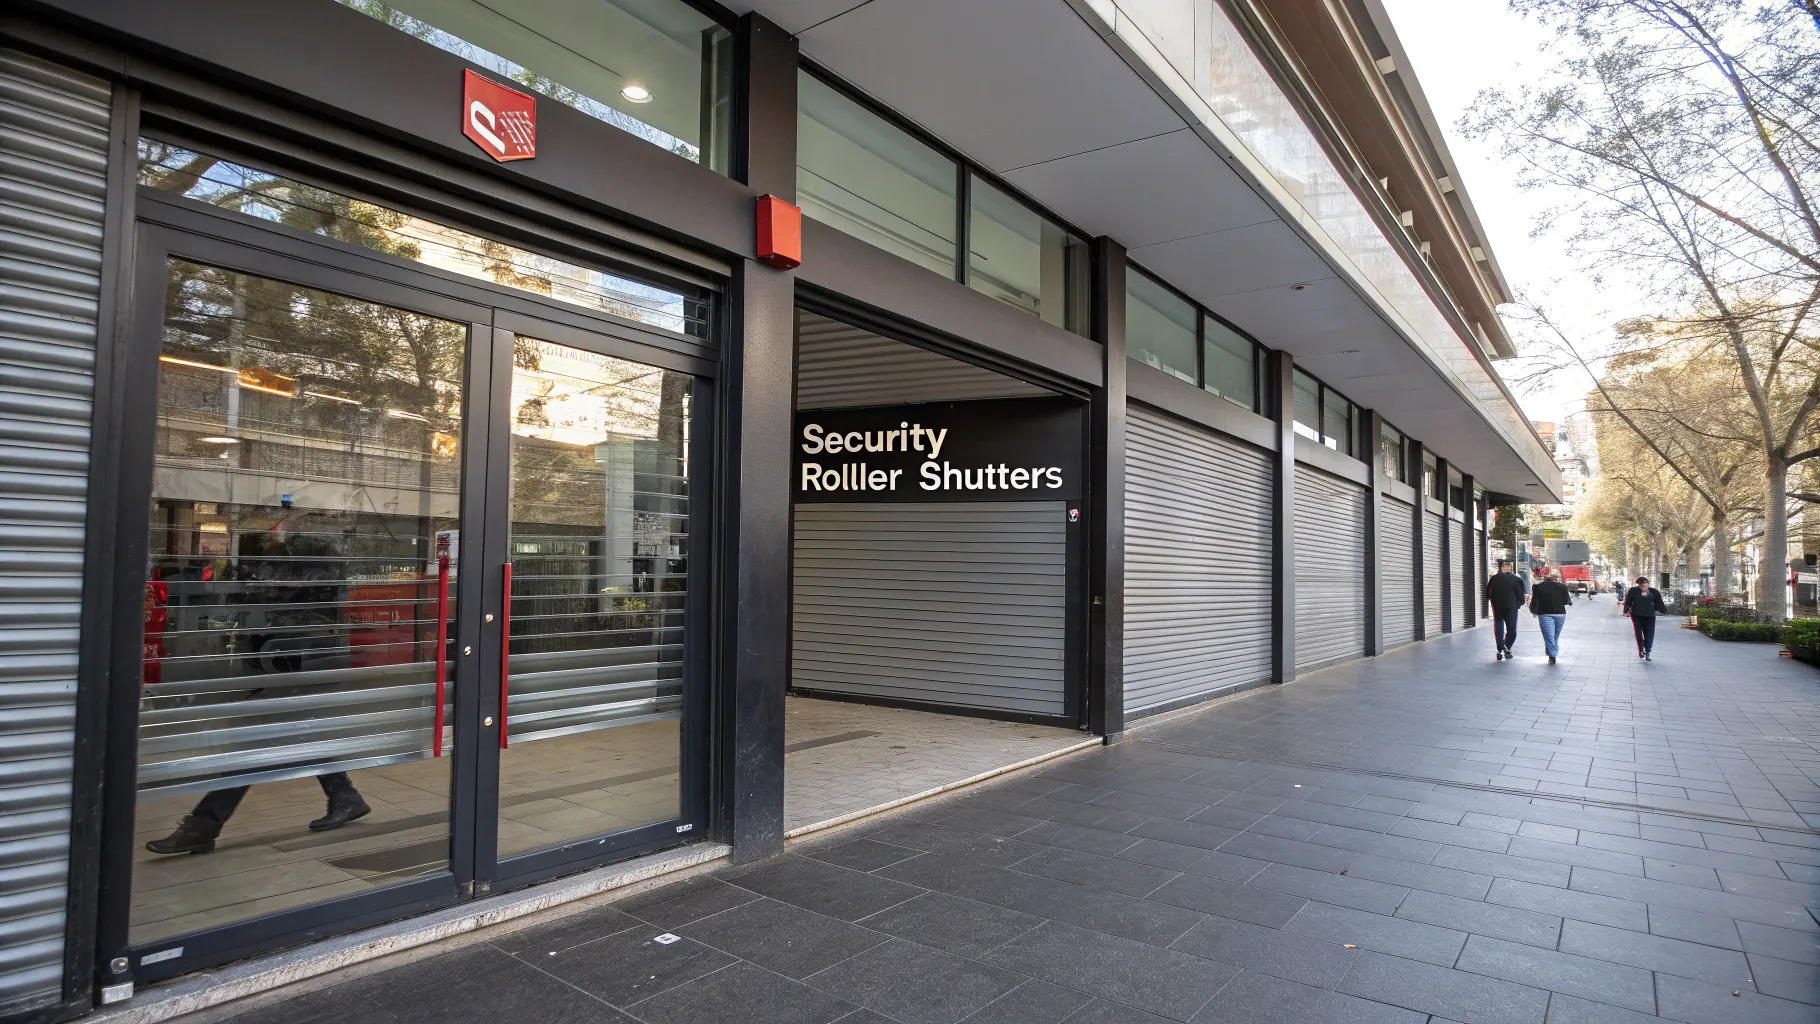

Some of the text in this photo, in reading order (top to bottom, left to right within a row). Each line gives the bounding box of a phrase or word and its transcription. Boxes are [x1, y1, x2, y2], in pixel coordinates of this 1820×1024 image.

[802, 421, 948, 460] Security
[801, 461, 1063, 491] Rolller Shutters
